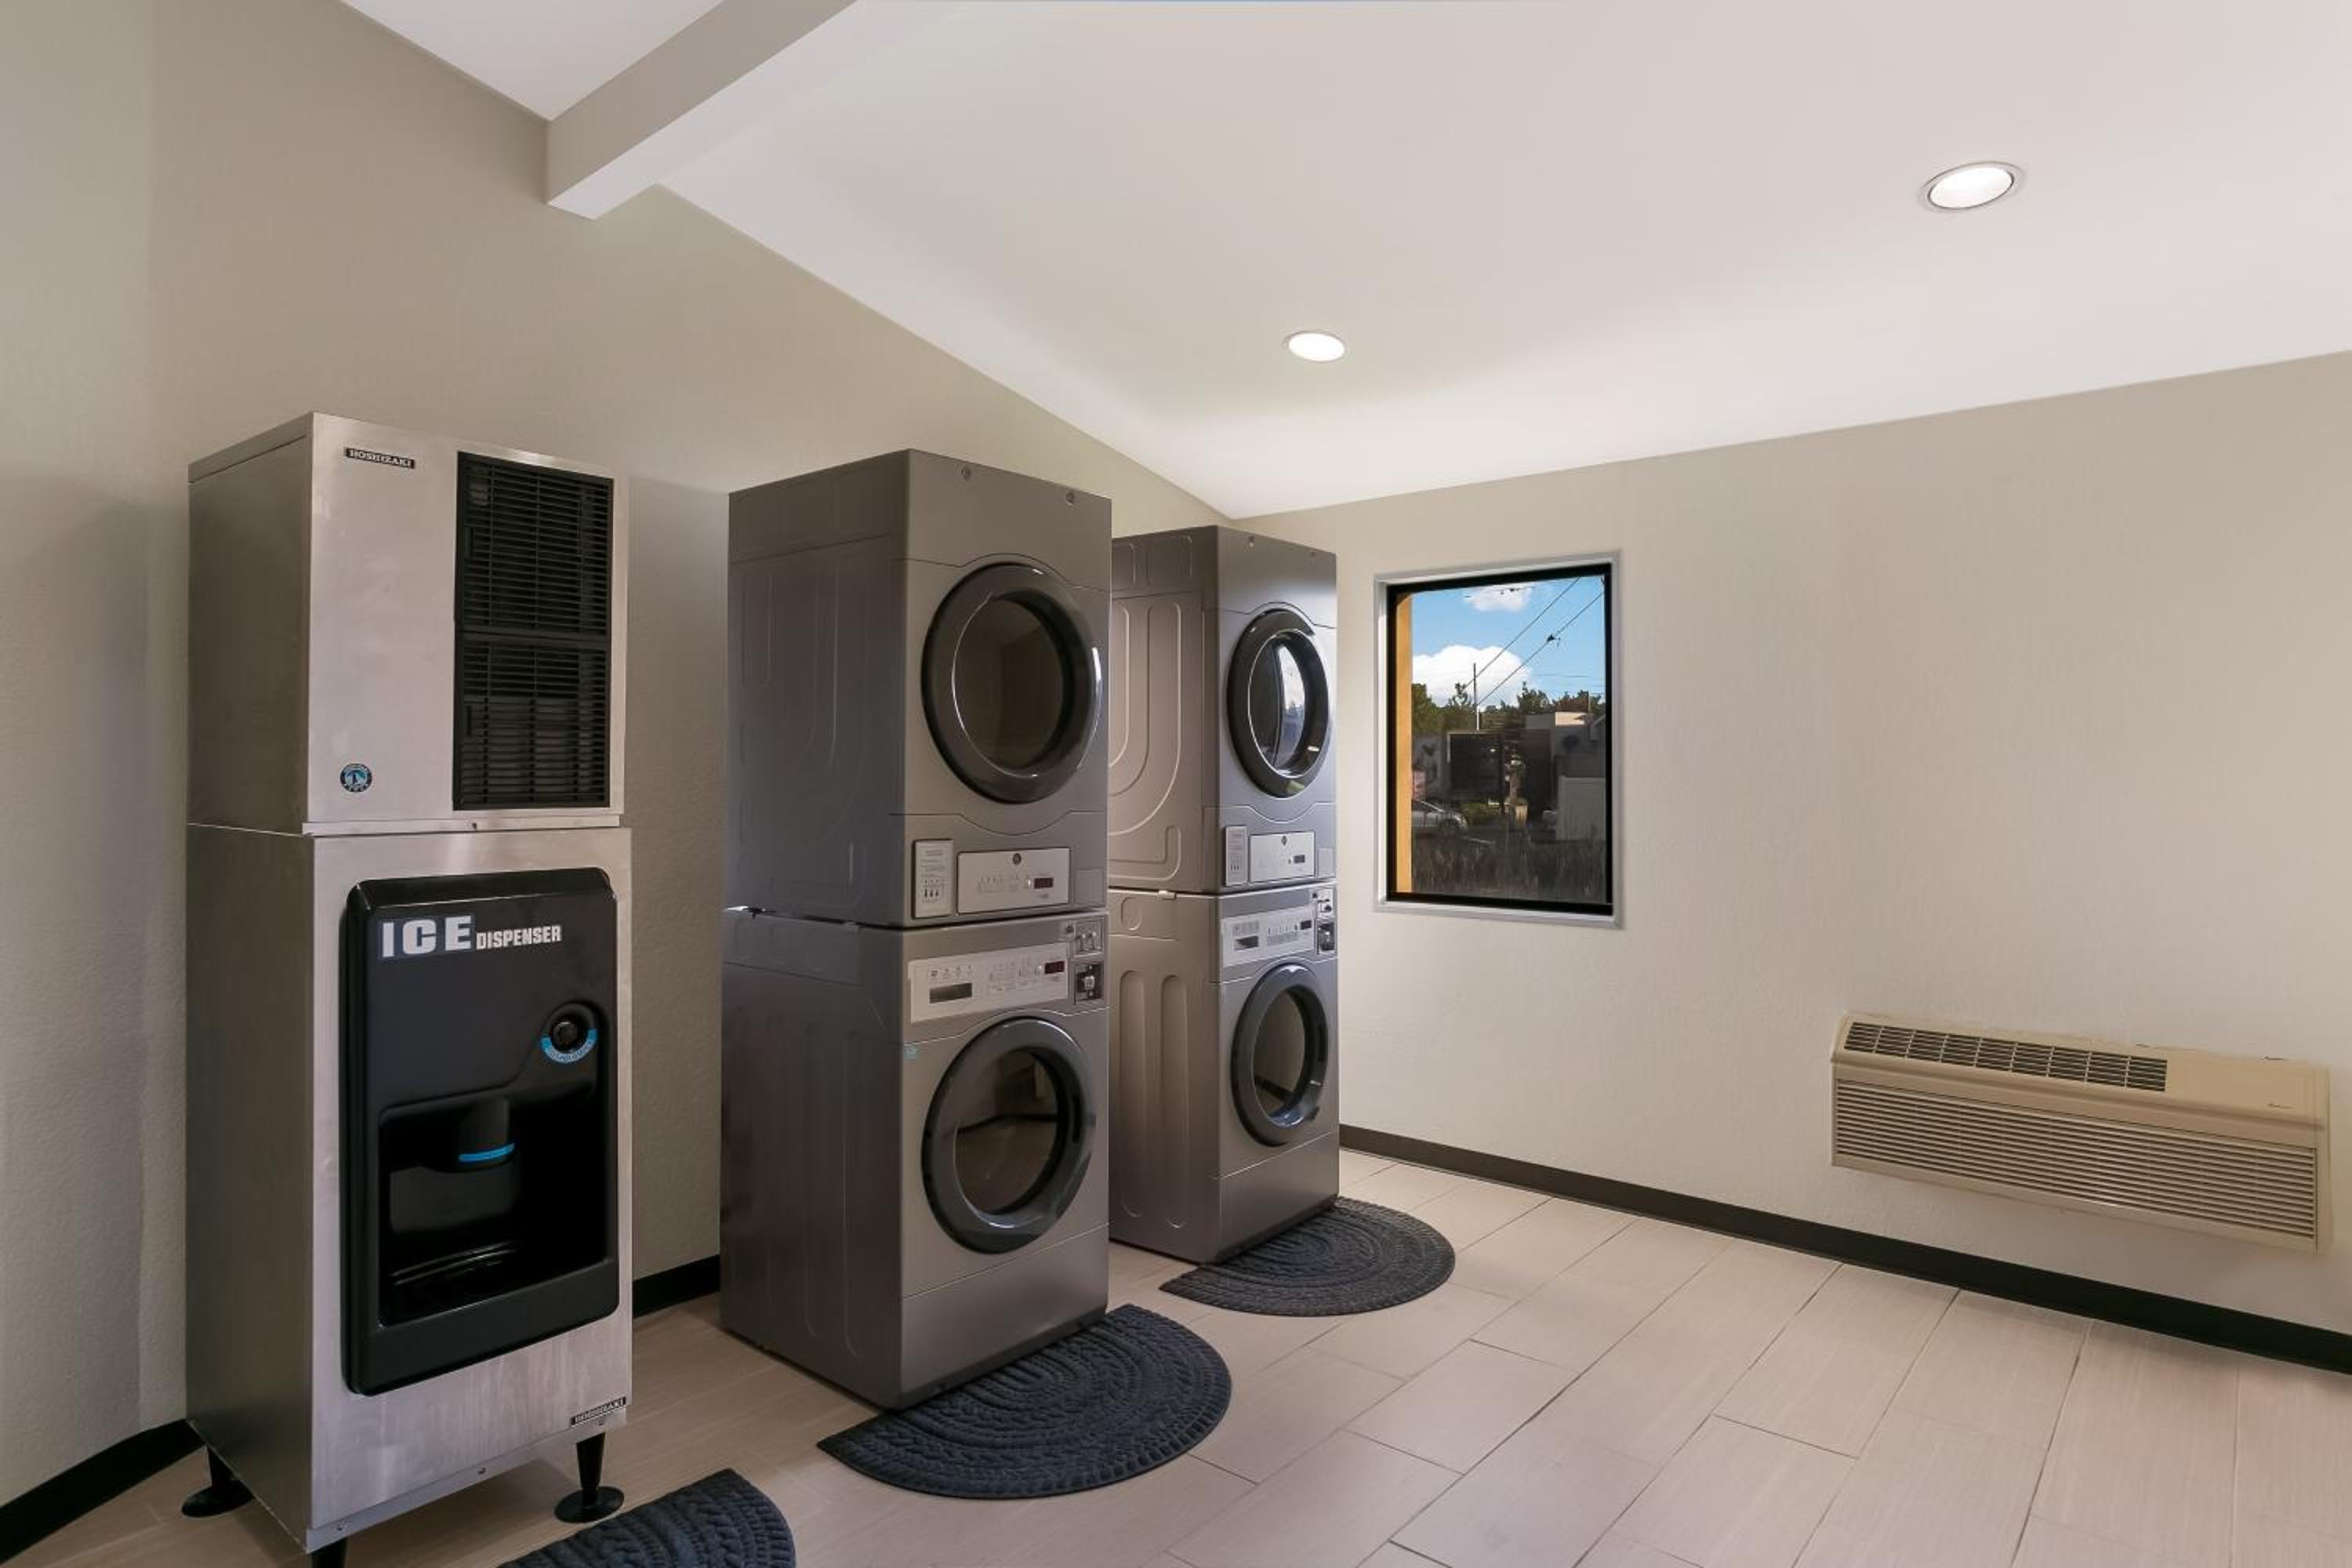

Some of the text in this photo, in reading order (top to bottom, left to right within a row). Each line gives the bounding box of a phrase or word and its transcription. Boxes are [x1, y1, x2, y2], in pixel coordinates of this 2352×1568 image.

[347, 448, 412, 467] HOSHIZAKI
[383, 916, 561, 957] ICE DISPENSER
